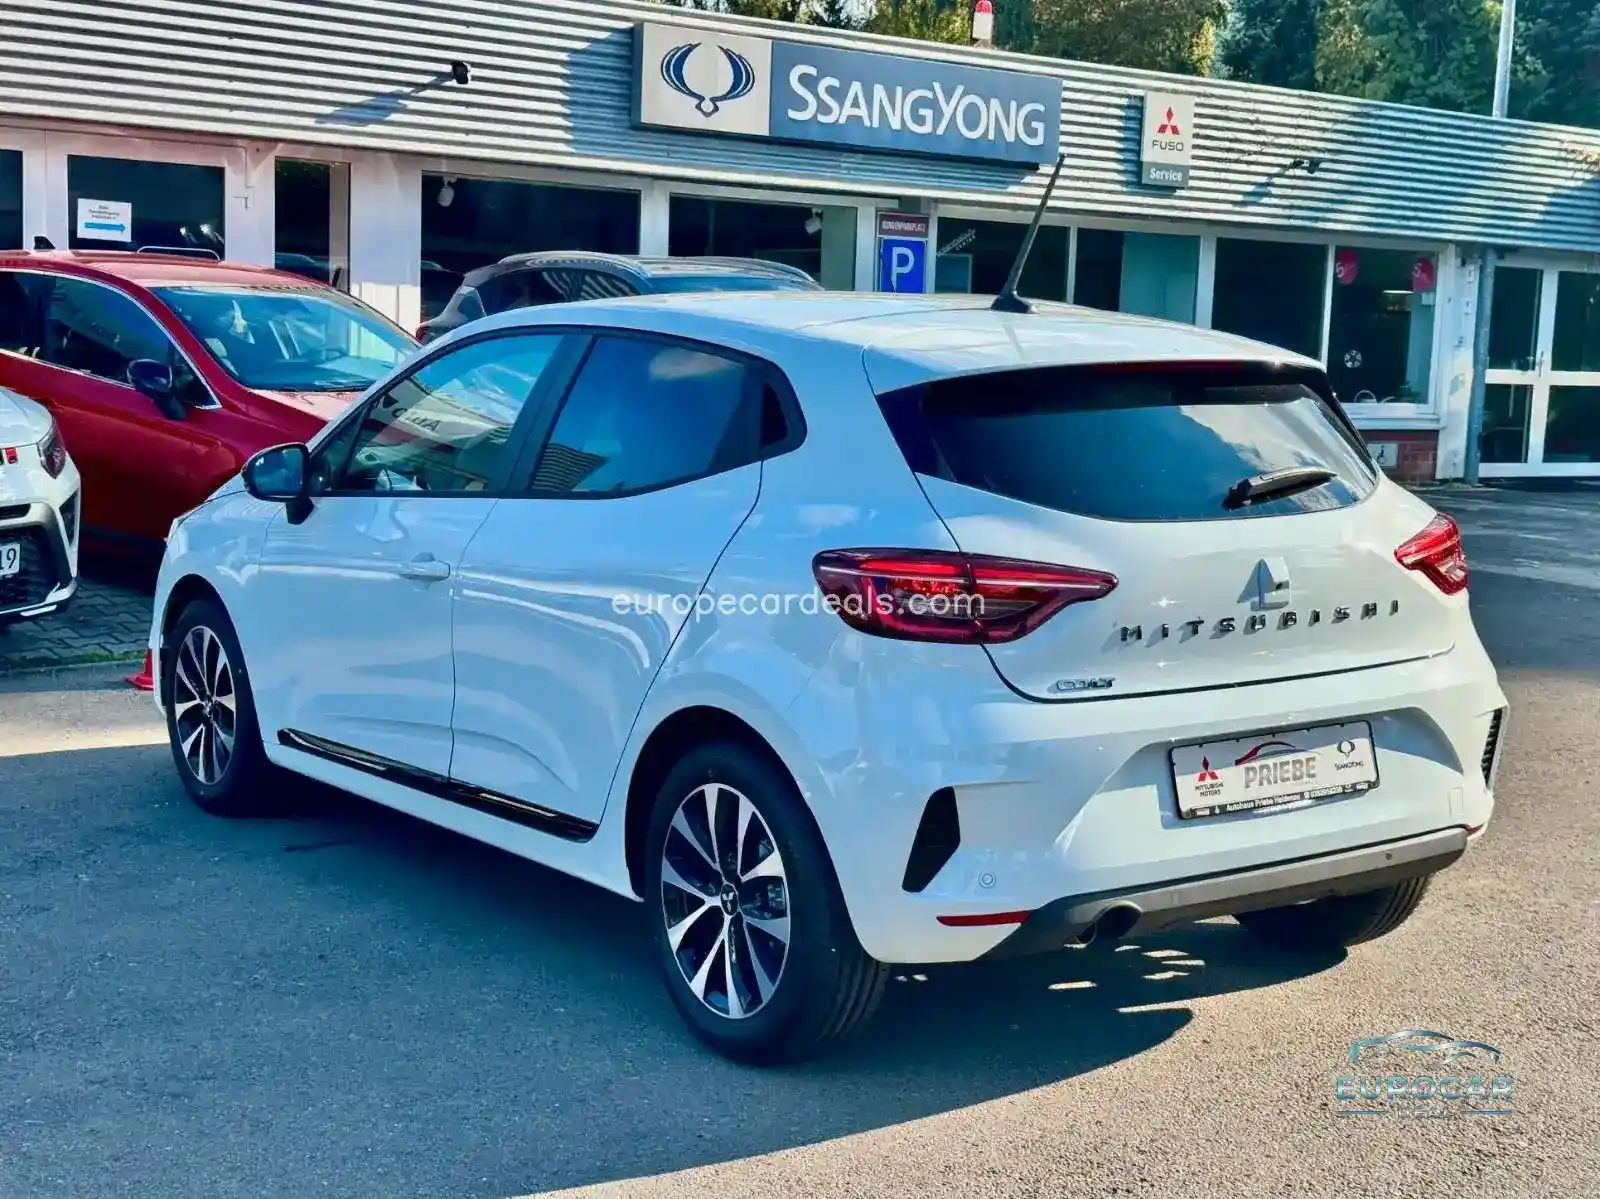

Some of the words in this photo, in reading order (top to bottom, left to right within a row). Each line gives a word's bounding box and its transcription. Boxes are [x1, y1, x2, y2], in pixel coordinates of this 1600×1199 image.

[1152, 140, 1184, 152] FUSO
[1149, 167, 1183, 181] Service
[891, 246, 915, 291] P
[1120, 600, 1399, 642] MITSUBISHI
[1244, 756, 1317, 788] PRIEBE
[1195, 782, 1224, 790] MITSUBISHI
[1200, 789, 1221, 797] MOTORS
[1226, 800, 1255, 811] Autohaus
